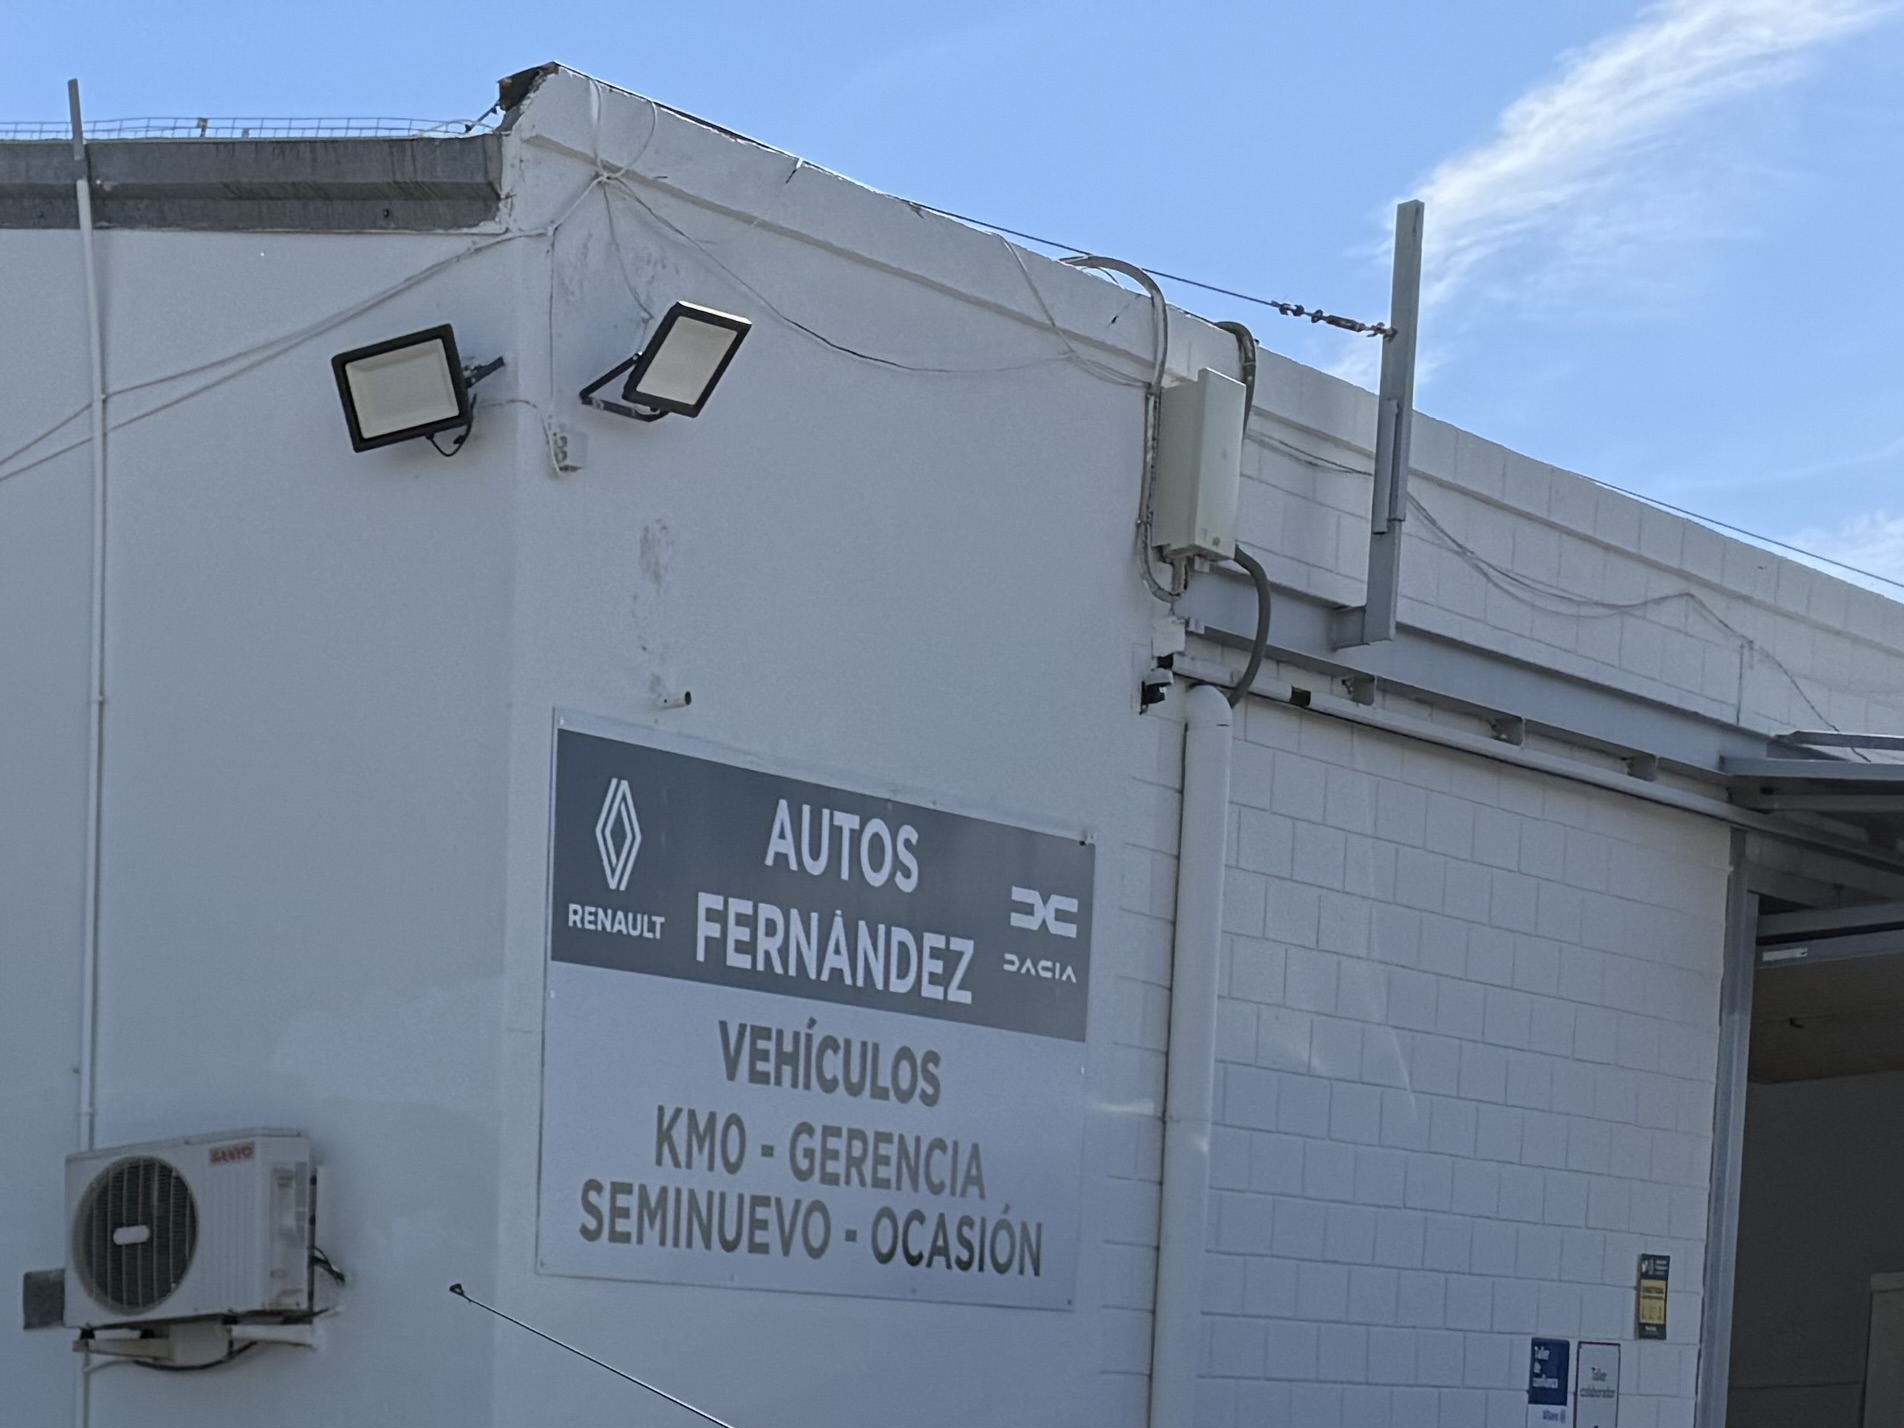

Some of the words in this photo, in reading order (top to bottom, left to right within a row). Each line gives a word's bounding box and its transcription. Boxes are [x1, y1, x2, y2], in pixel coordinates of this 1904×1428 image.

[764, 799, 919, 893] AUTOS
[568, 903, 665, 940] RENAULT
[696, 892, 975, 1005] FERNÁNDEZ
[1002, 953, 1077, 983] DACIA
[718, 1017, 942, 1107] VEHÍCULOS
[789, 1121, 986, 1200] GERENCIA
[579, 1178, 831, 1260] SEMINUEVO
[870, 1203, 1043, 1278] OCASIÓN
